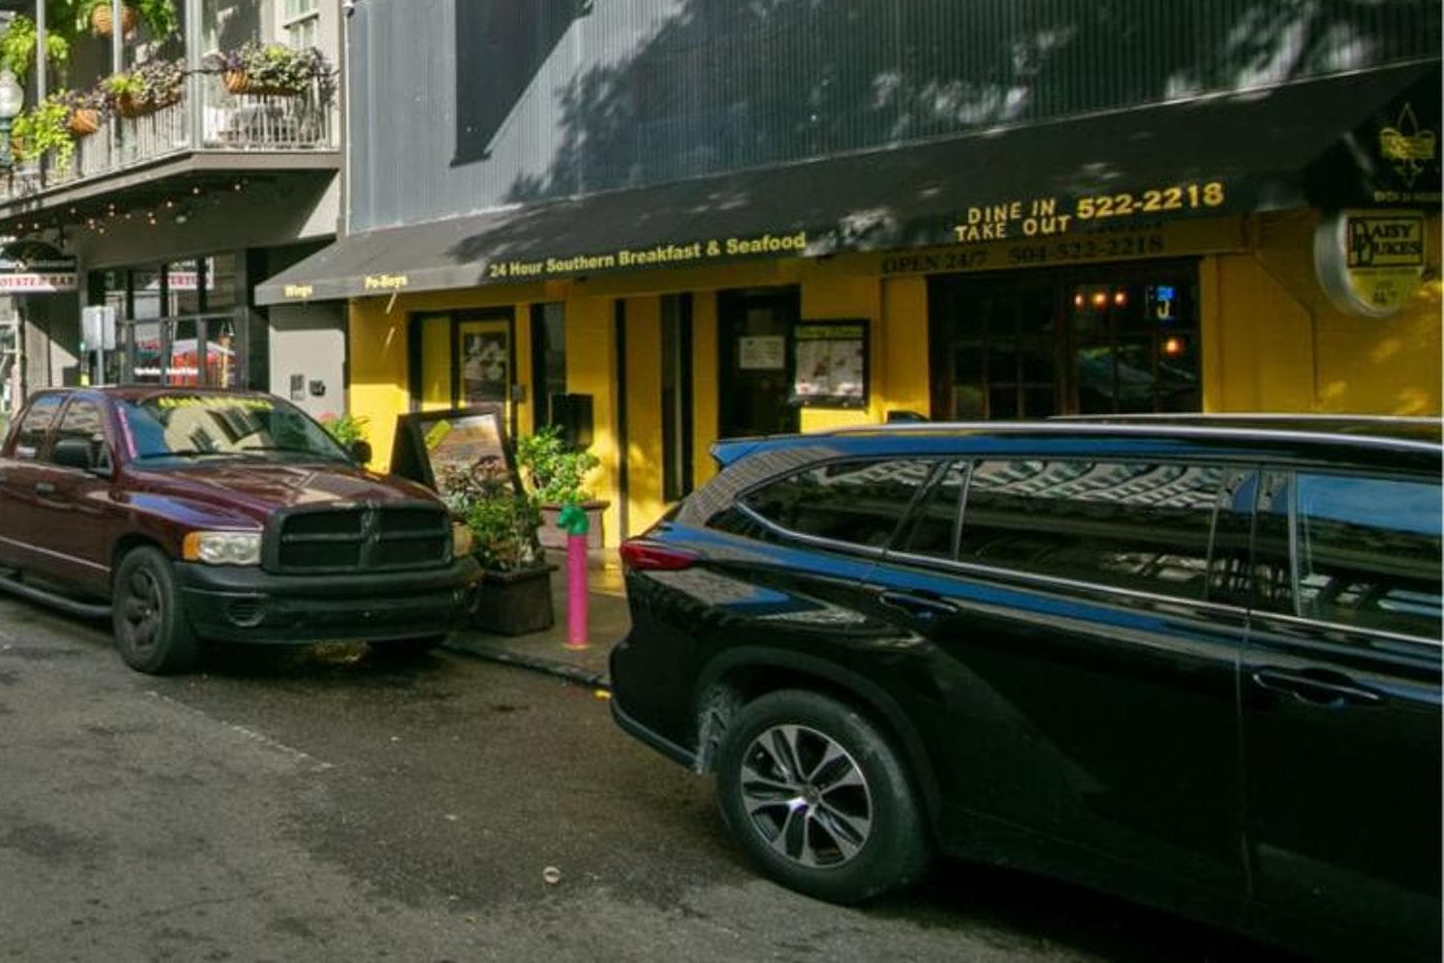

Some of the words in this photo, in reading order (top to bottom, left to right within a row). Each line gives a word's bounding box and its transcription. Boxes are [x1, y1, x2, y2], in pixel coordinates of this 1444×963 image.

[968, 201, 1022, 225] DINE
[1032, 198, 1056, 217] IN
[1077, 182, 1225, 220] 522-2218
[955, 221, 1006, 242] TAKE
[1023, 214, 1072, 236] OUT
[489, 264, 507, 278] 24
[510, 260, 543, 276] Hour
[545, 252, 615, 273] Southern
[619, 241, 702, 265] Breakfast
[706, 240, 721, 256] &
[726, 230, 806, 255] Seafood
[881, 255, 936, 273] OPEN
